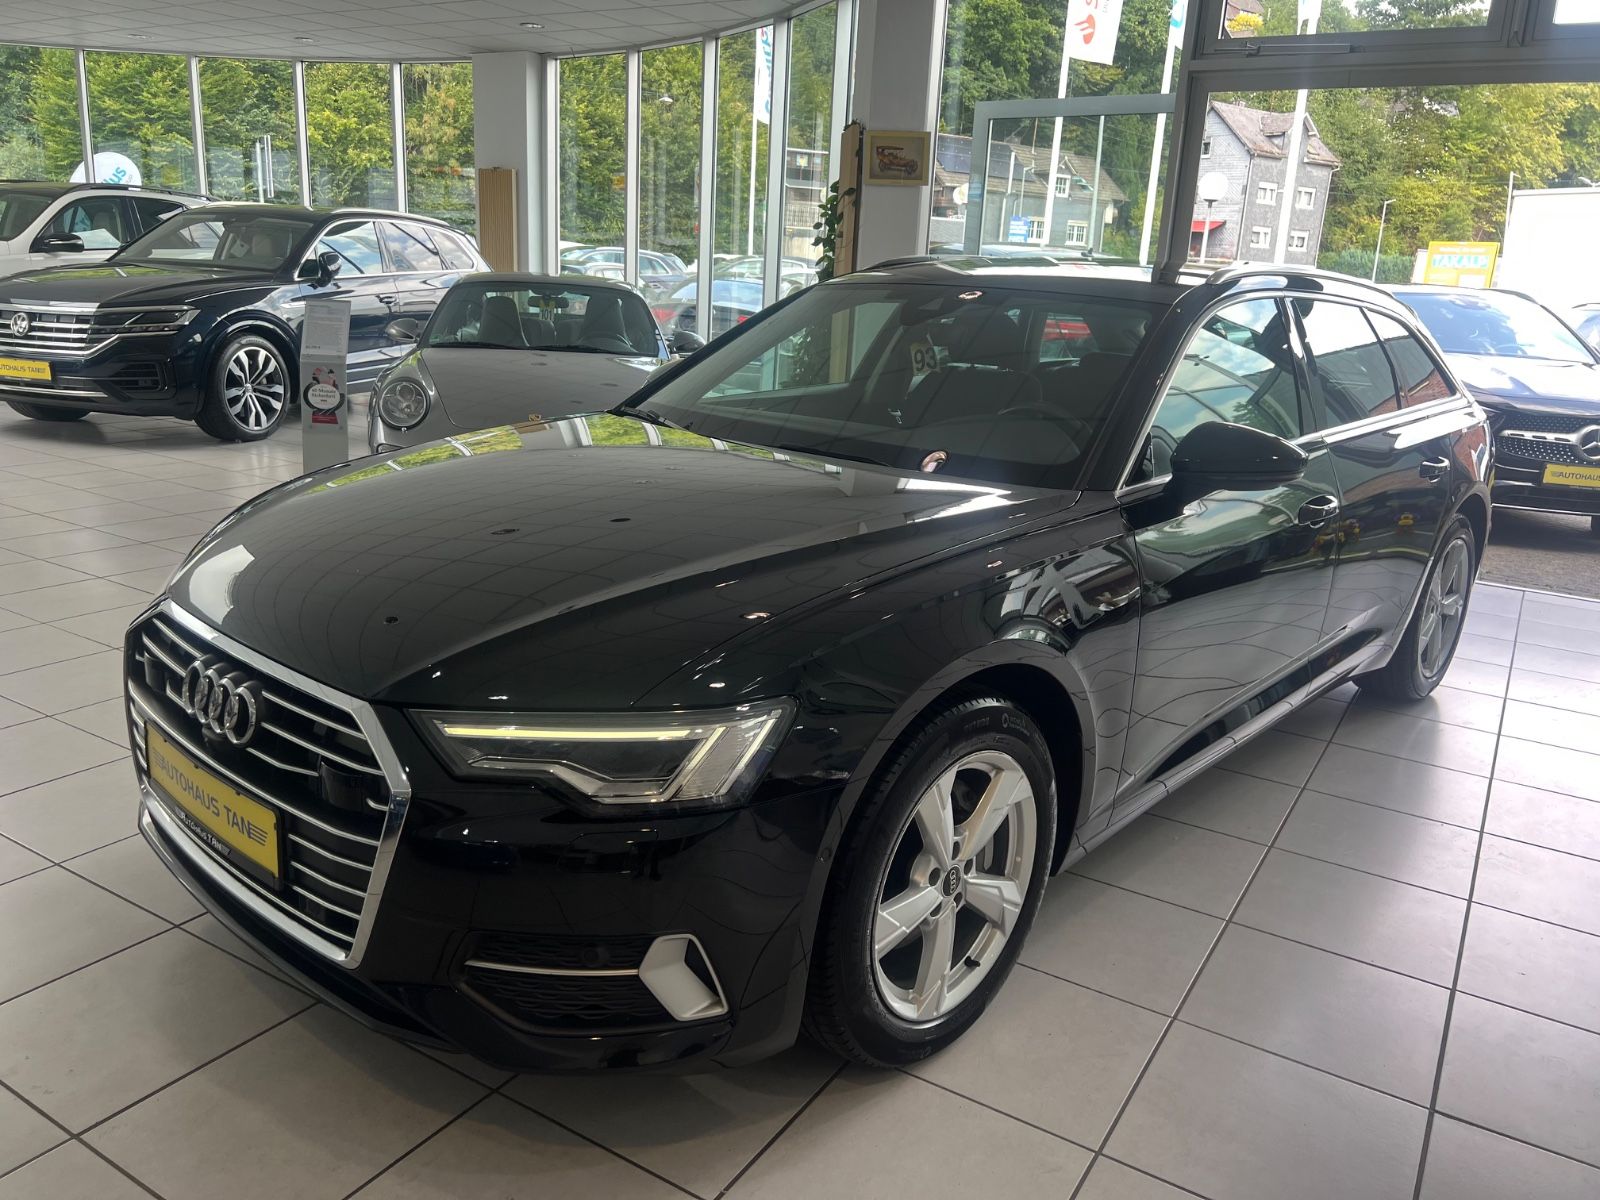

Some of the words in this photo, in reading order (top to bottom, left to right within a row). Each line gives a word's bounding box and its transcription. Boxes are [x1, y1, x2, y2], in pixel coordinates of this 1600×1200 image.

[914, 347, 937, 371] 93
[160, 758, 221, 819] AUTOHAUS
[224, 804, 252, 840] TAN
